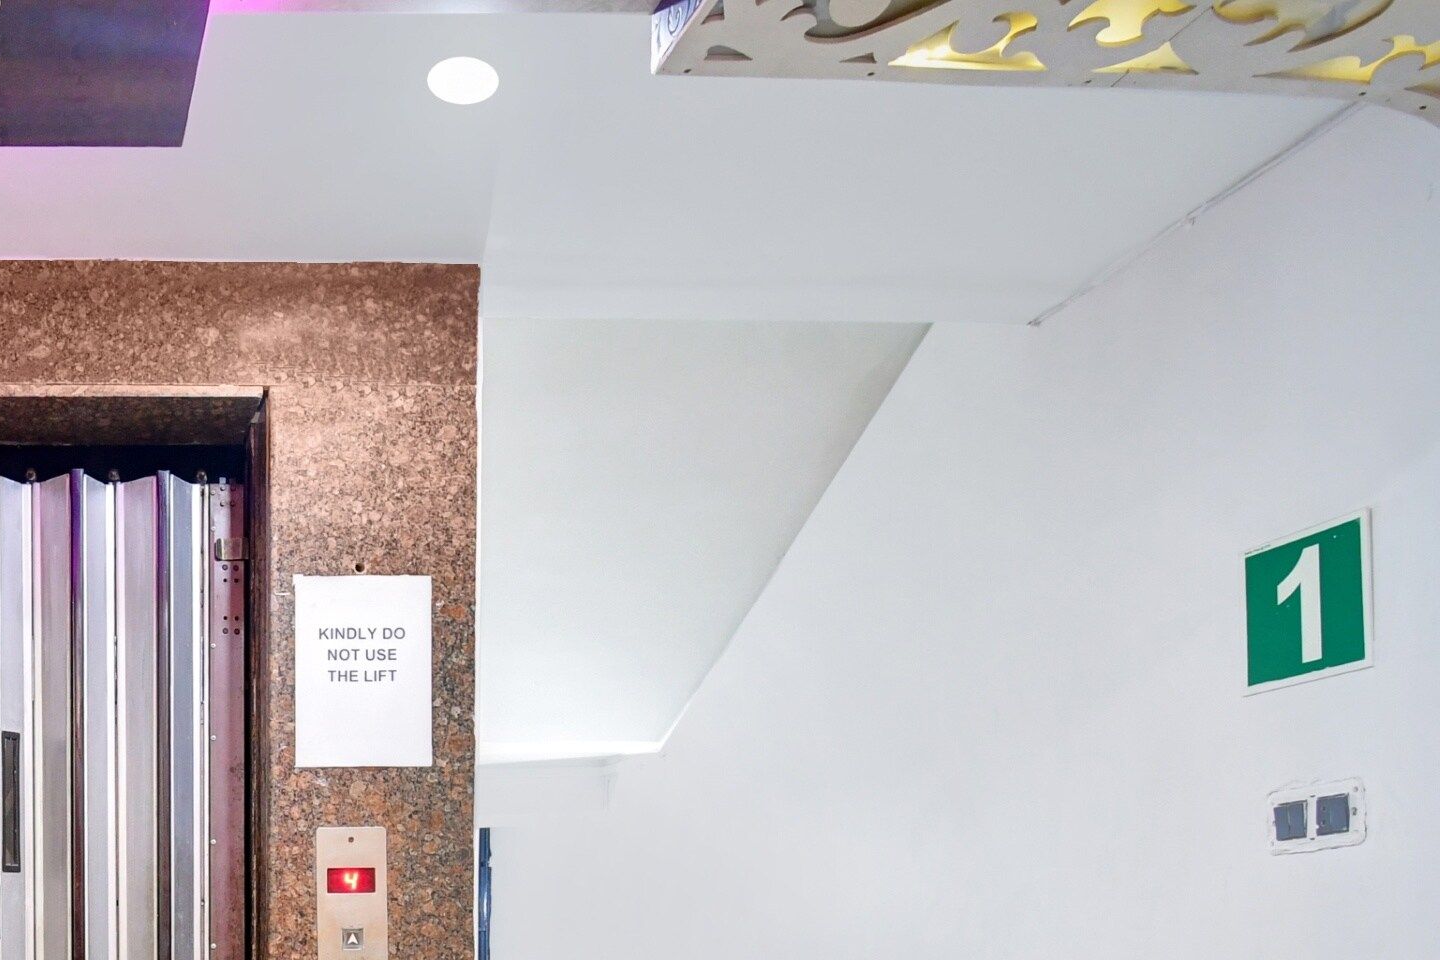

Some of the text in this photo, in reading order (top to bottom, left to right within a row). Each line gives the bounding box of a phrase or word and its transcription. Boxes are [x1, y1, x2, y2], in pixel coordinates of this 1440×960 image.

[1276, 543, 1323, 664] 1
[318, 627, 406, 640] KINDLY DO
[327, 648, 397, 661] NOT USE
[327, 669, 397, 682] THE LIFT
[344, 872, 359, 890] 4
